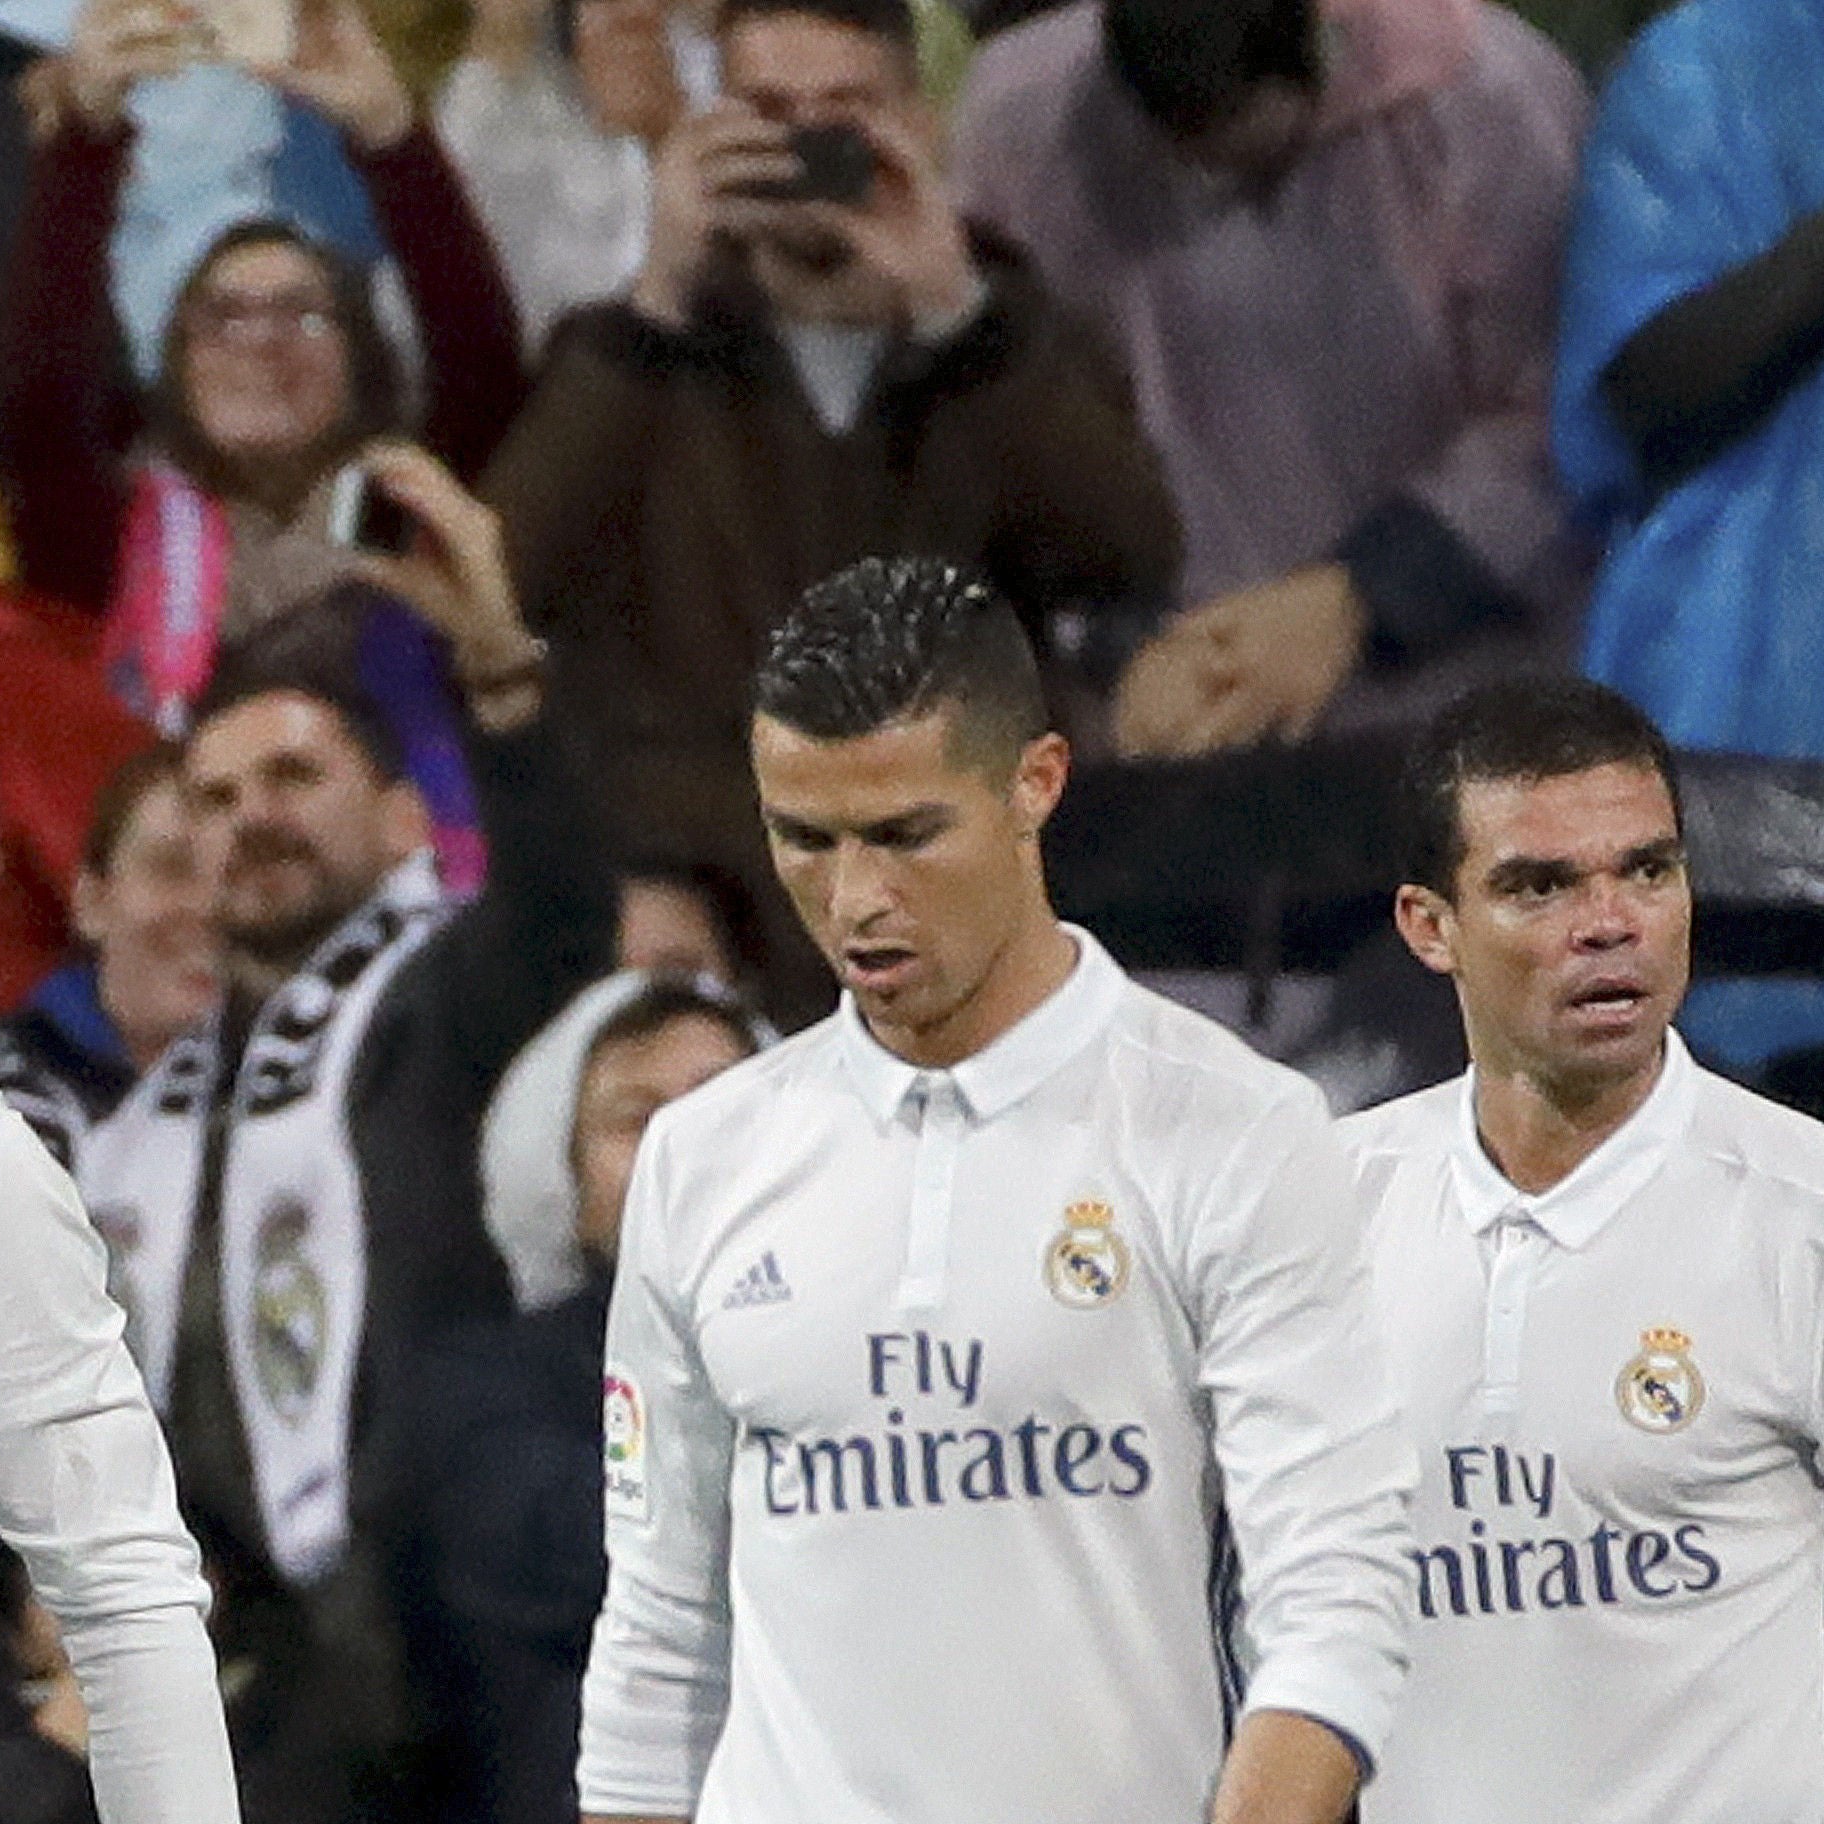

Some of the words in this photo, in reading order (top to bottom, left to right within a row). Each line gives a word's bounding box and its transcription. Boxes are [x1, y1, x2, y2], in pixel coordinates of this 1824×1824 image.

[867, 1330, 983, 1404] Fly
[746, 1408, 1152, 1516] Emirates
[1444, 1443, 1555, 1518] Fly
